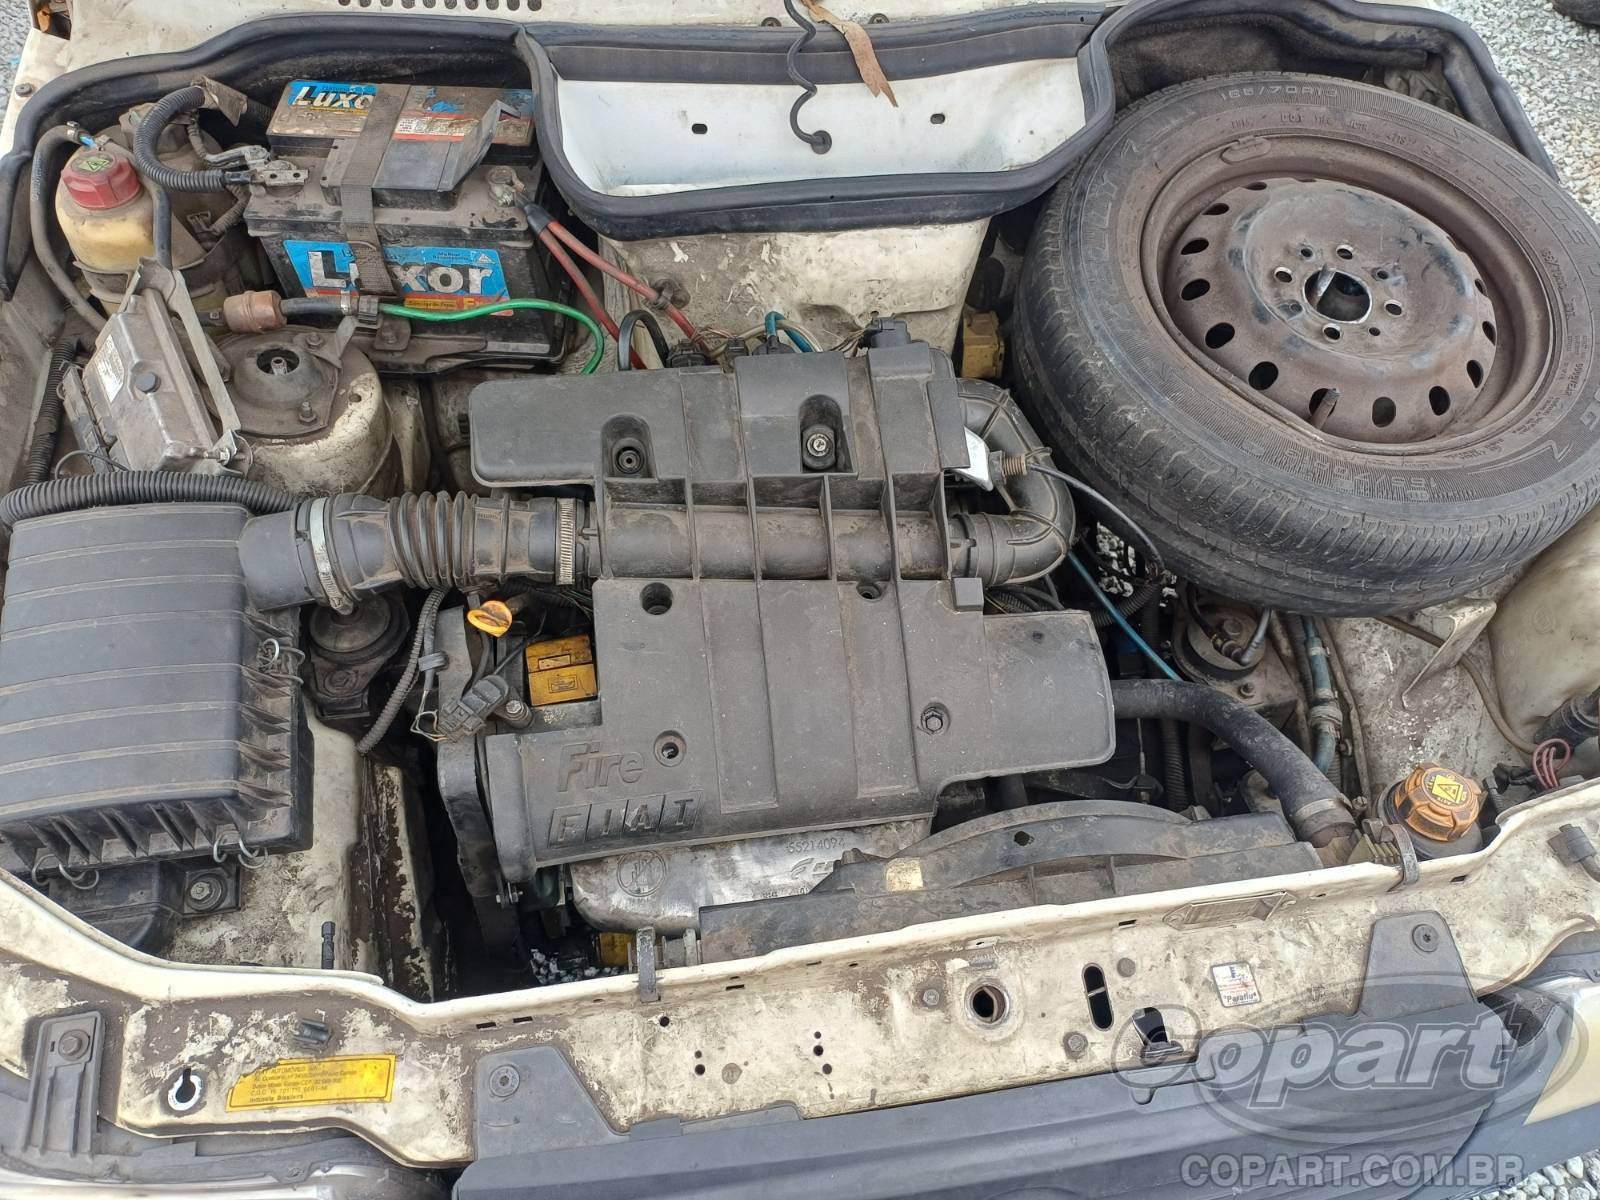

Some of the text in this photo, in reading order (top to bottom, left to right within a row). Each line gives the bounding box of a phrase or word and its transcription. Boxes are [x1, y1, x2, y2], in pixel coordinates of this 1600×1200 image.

[292, 86, 376, 109] Luxo
[558, 741, 645, 792] Fire
[557, 798, 695, 842] FIAT
